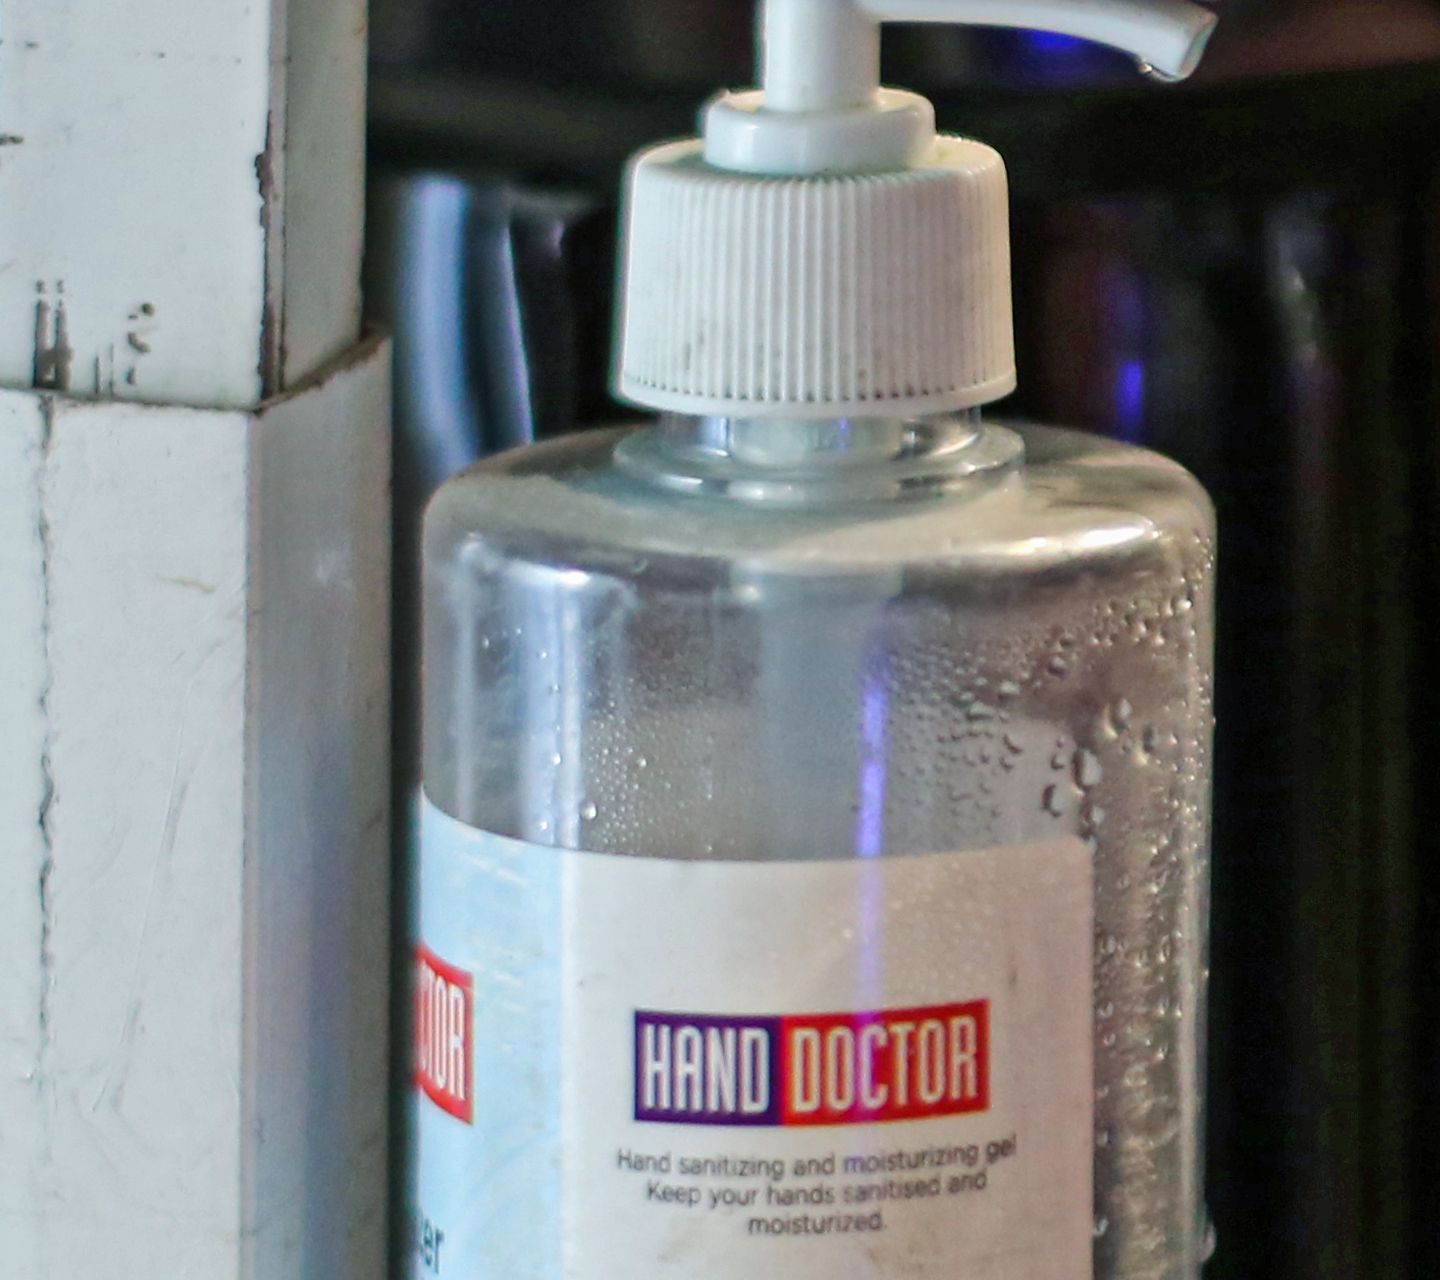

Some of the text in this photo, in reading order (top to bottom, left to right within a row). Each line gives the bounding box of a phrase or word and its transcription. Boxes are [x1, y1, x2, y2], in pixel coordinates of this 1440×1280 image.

[642, 1015, 979, 1113] HAND DOCTOR
[617, 1134, 1017, 1181] Hand sanitizing and moisturizing gel
[647, 1169, 987, 1208] Keep your hands sanitised and
